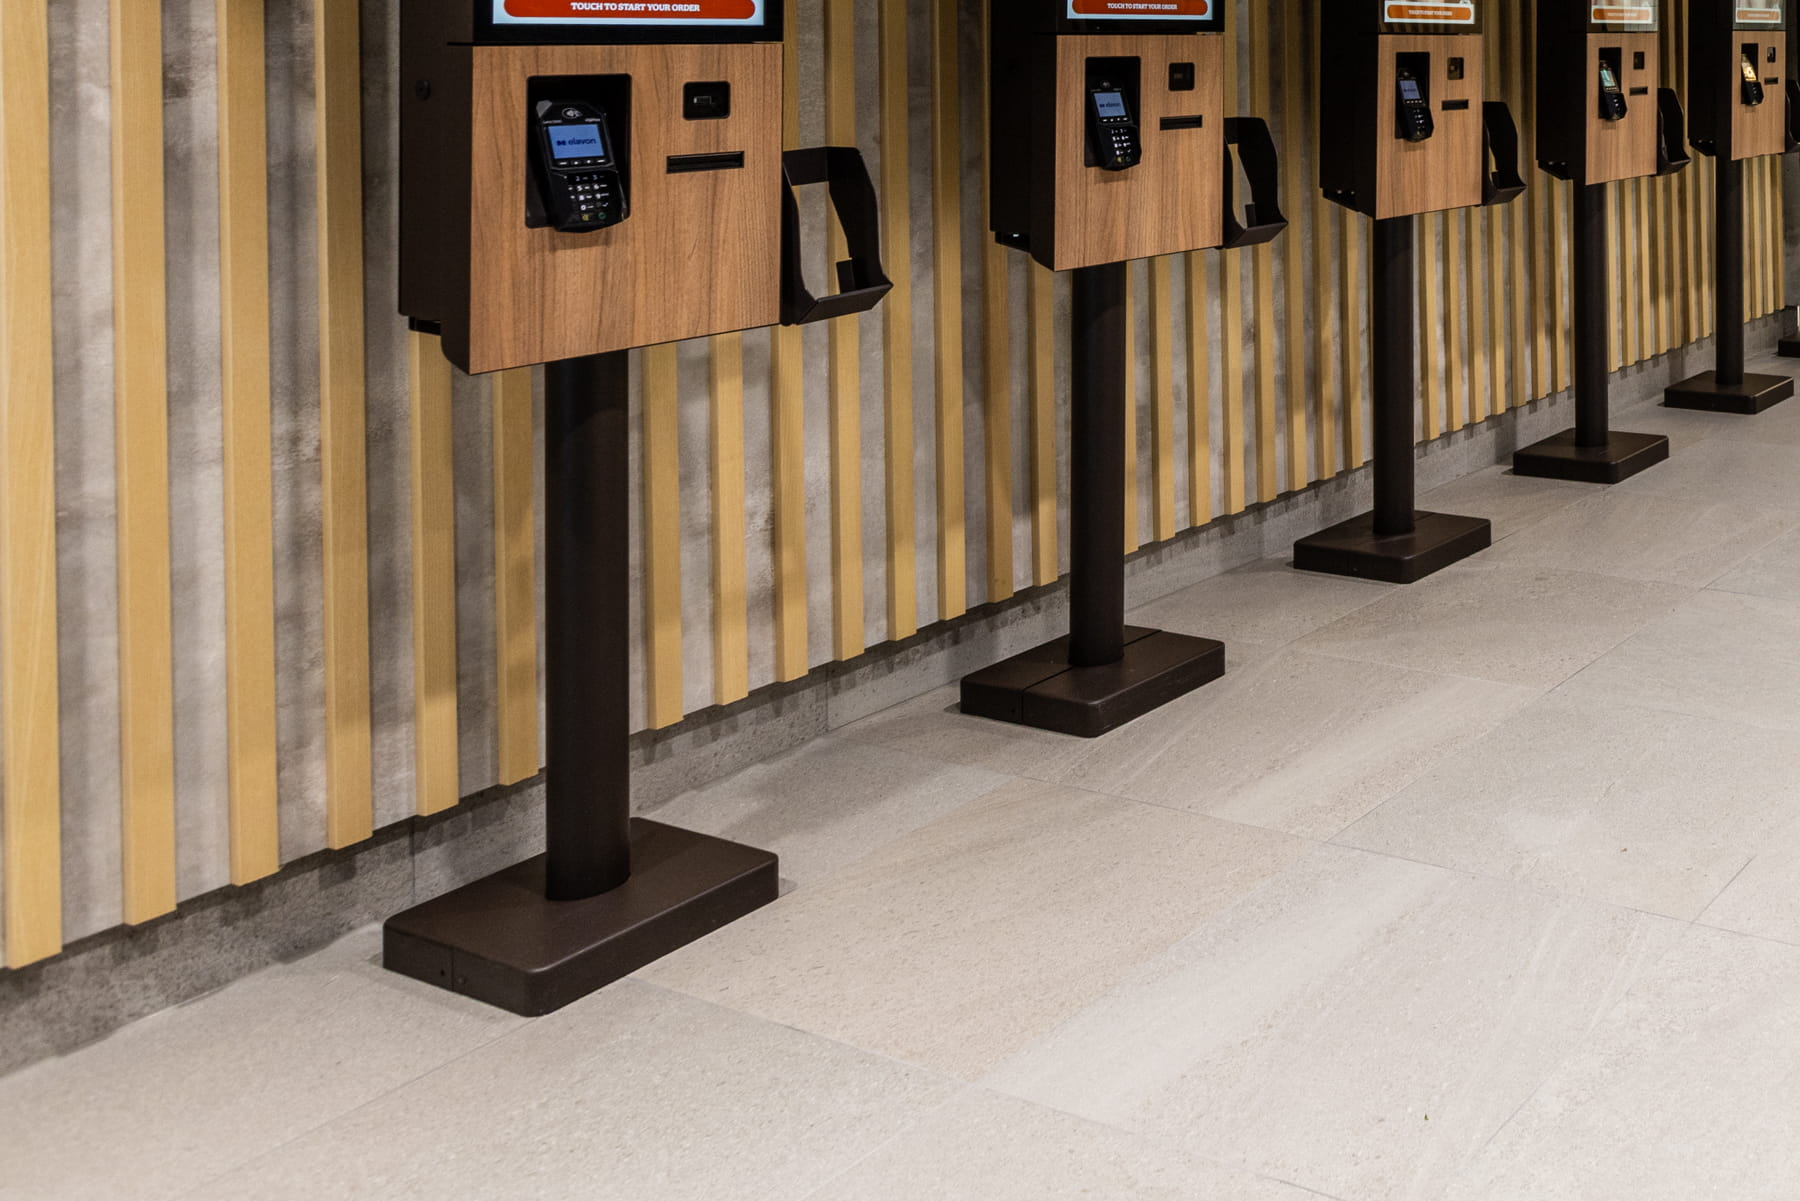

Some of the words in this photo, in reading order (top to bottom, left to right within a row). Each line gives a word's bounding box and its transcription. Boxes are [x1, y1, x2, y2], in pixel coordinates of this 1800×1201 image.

[570, 2, 603, 11] TOUCH
[604, 2, 617, 11] TO
[618, 2, 646, 12] START
[647, 3, 671, 12] YOUR
[671, 3, 700, 12] ORDER
